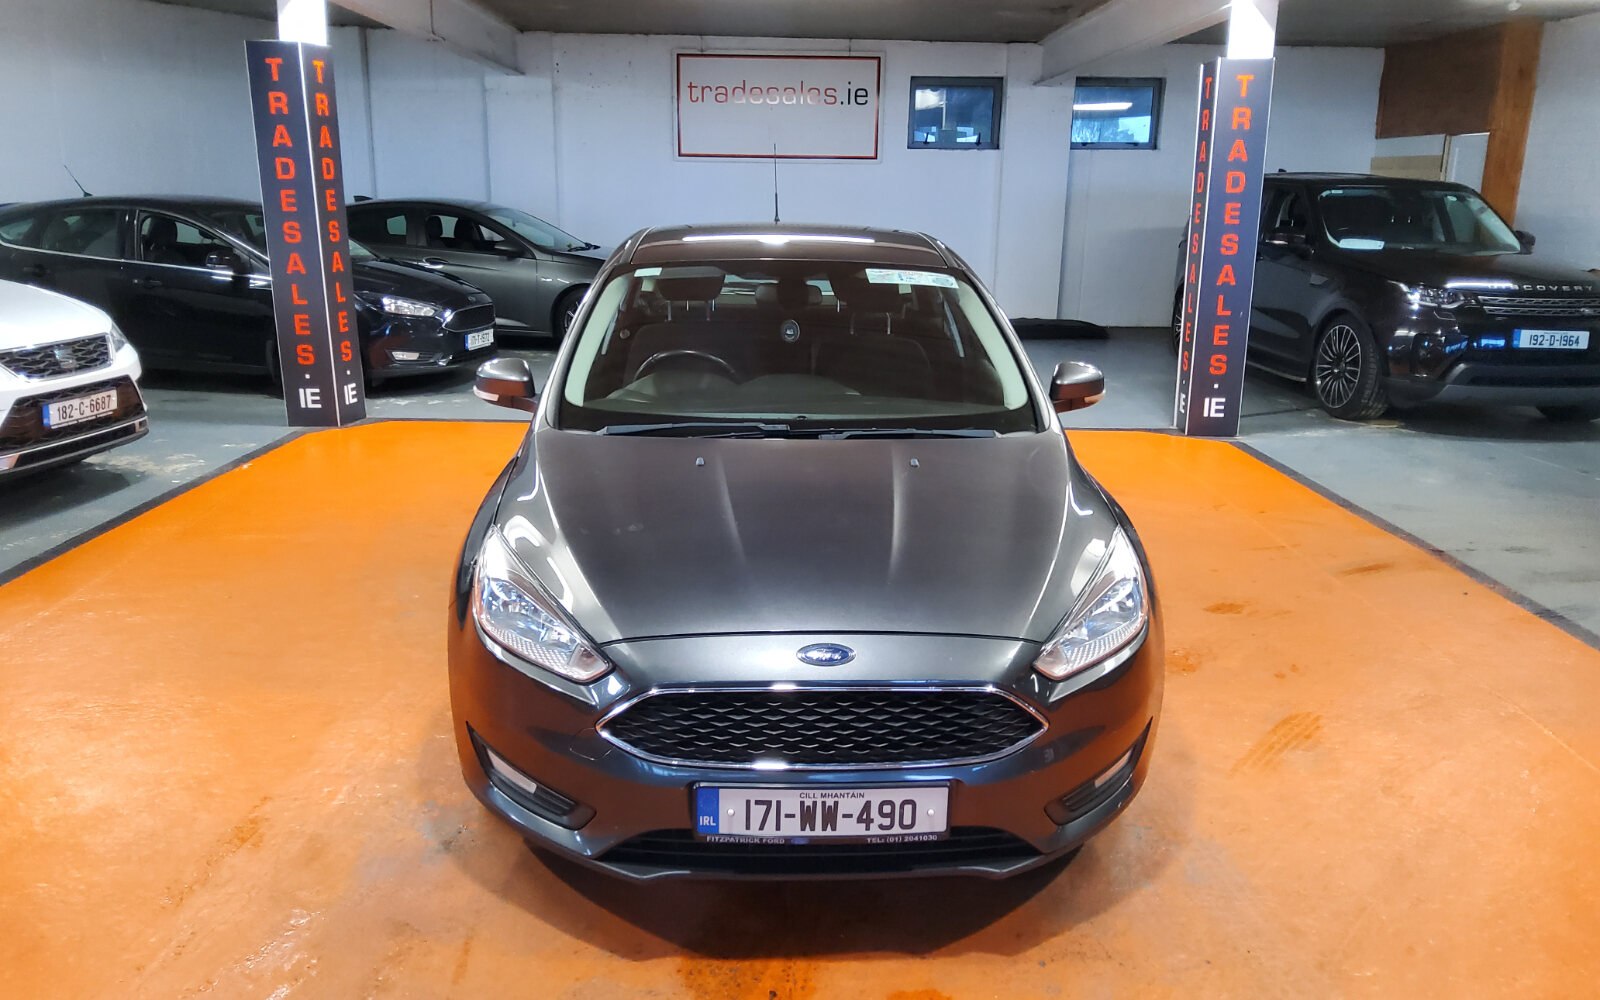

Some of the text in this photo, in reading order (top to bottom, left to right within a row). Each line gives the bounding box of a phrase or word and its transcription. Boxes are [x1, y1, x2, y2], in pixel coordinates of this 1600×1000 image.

[687, 80, 868, 105] tradesales.ie
[1529, 334, 1580, 347] 192-D-1964
[57, 394, 112, 420] 182-C-6687
[820, 791, 865, 799] MHANTÁIN
[699, 815, 716, 826] IRL
[745, 799, 917, 832] 171-WW-490
[706, 835, 785, 845] FITZPATRICK FORD
[886, 836, 902, 844] (01)
[904, 834, 938, 842] 2041030
